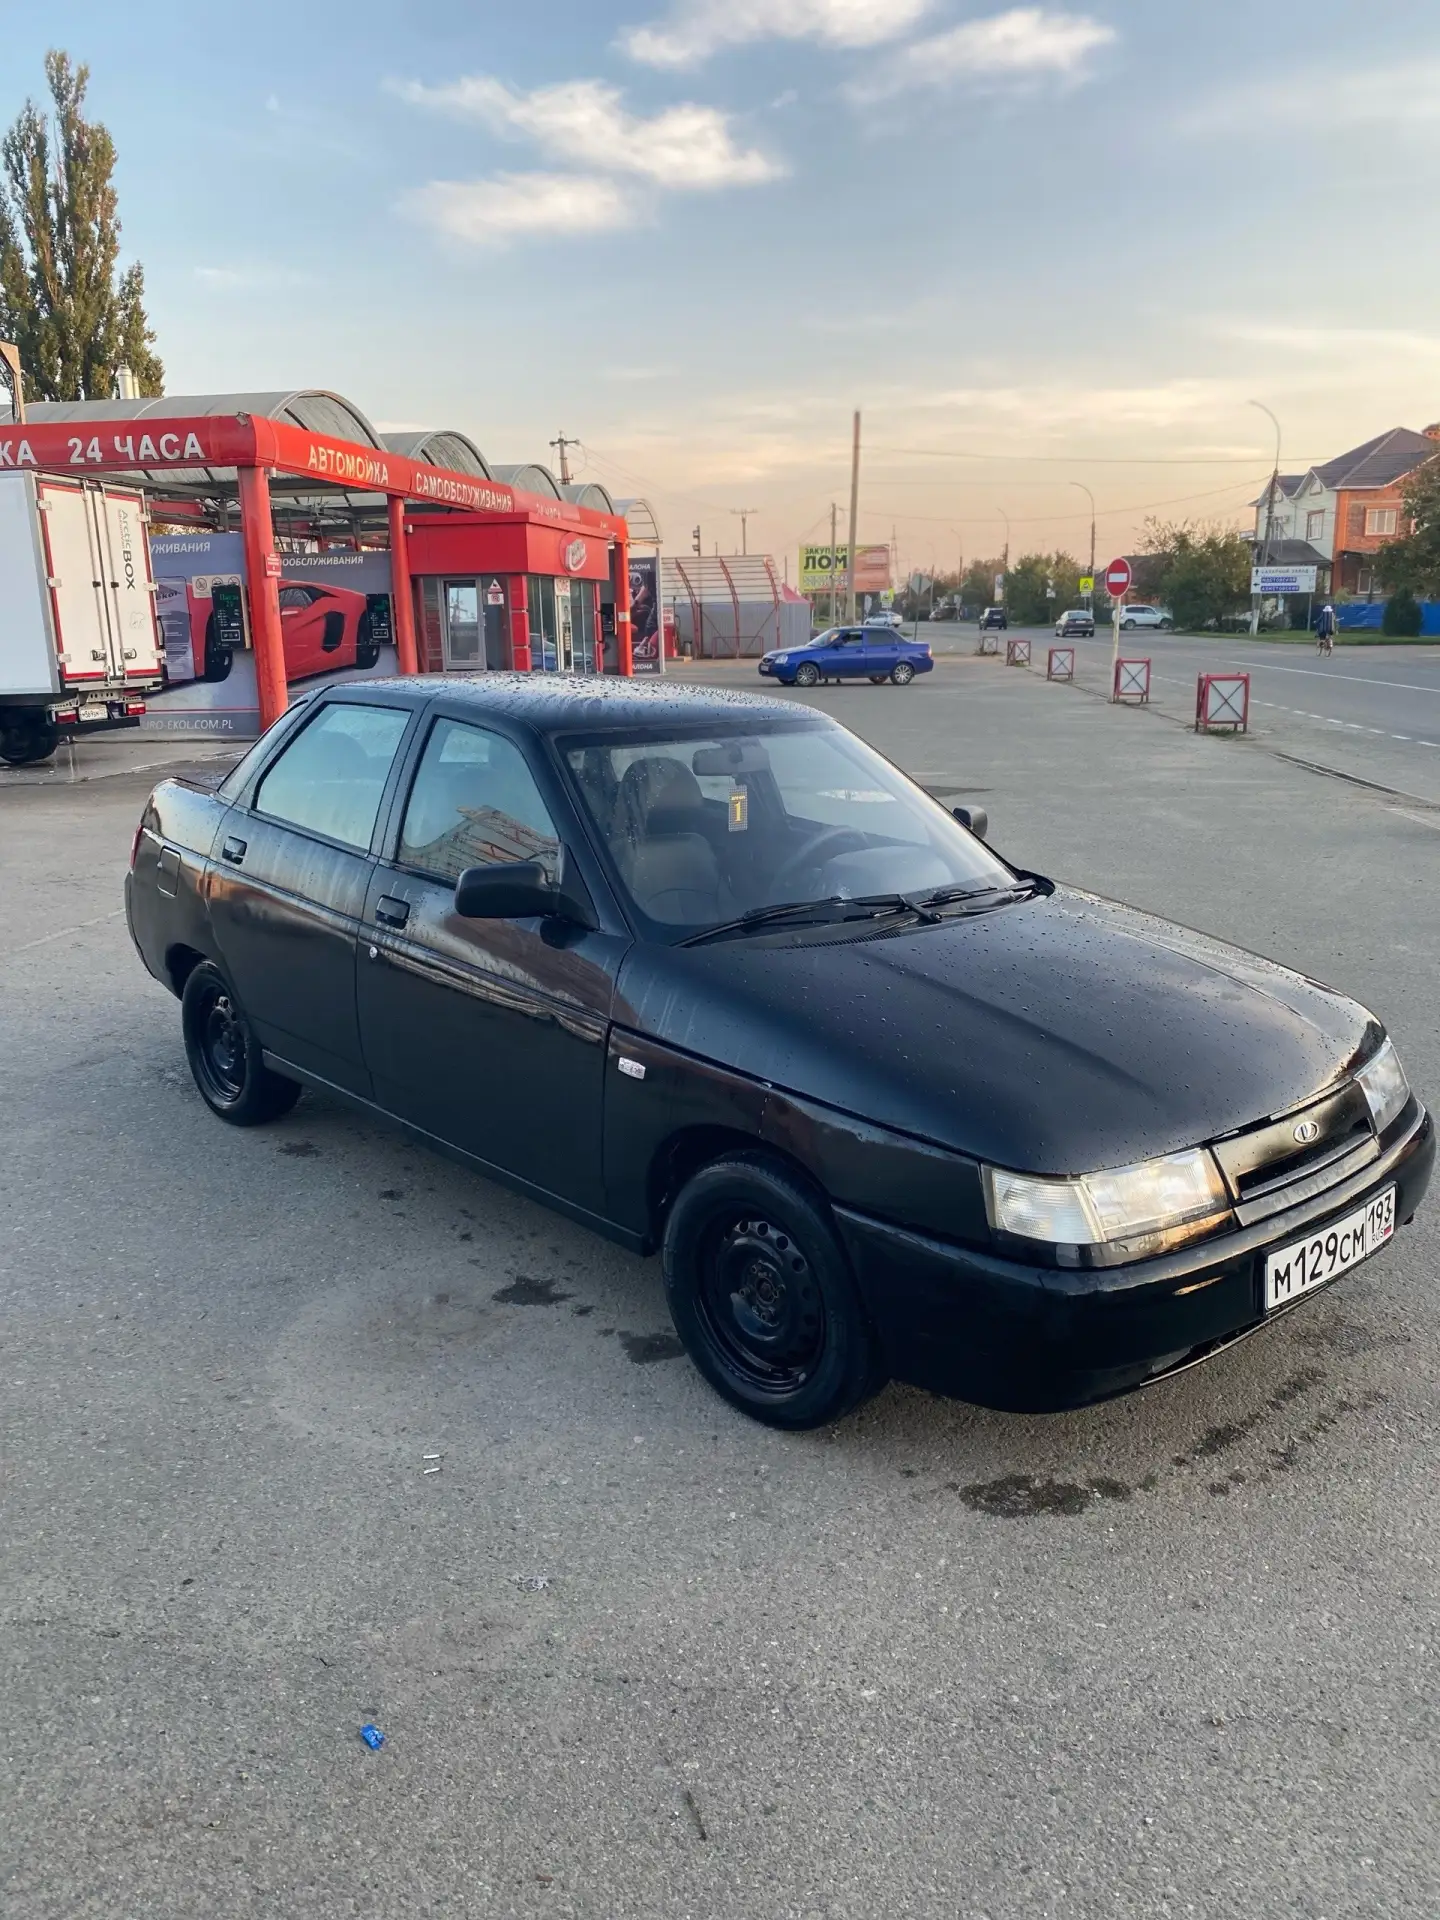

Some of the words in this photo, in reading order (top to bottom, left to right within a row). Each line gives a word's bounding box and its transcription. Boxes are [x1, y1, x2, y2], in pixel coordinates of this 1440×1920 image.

[0, 440, 38, 466] КА
[67, 437, 103, 464] 24
[114, 432, 206, 461] ЧАСА
[308, 444, 389, 485] АВТОМОЙКА
[415, 472, 512, 512] САМООБСЛУЖИВАНИЯ
[805, 547, 848, 555] ЗАКУПЕМ
[279, 555, 364, 566] ООБСЛУЖИВАНИЯ
[804, 555, 848, 570] ЛОМ
[1368, 1194, 1393, 1234] 193
[1371, 1228, 1384, 1243] RUS
